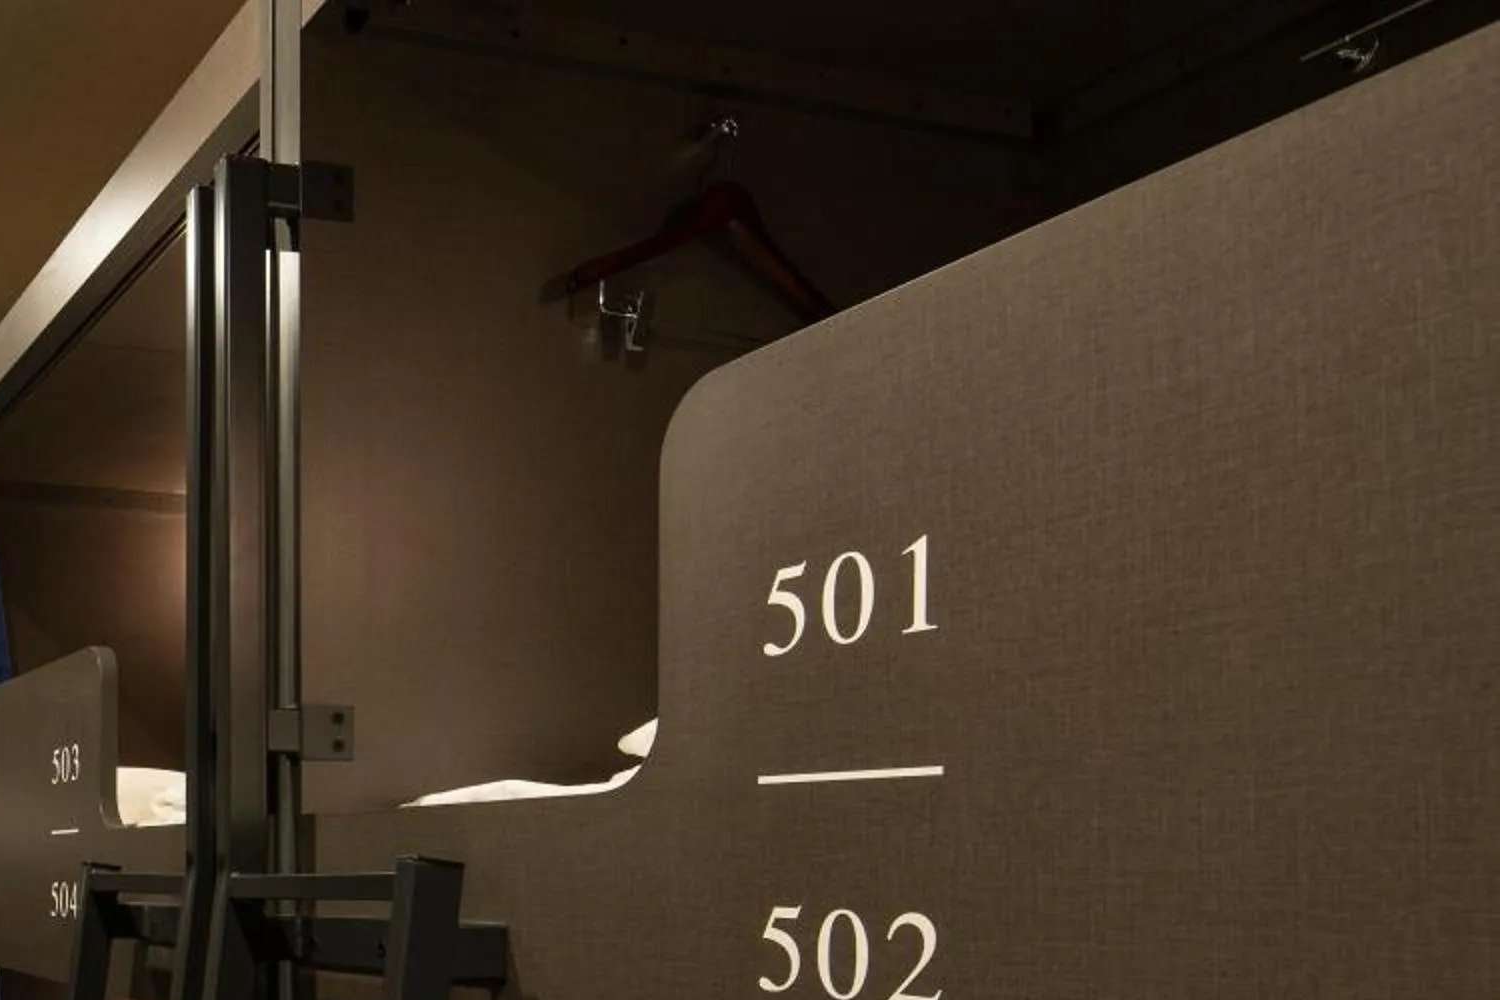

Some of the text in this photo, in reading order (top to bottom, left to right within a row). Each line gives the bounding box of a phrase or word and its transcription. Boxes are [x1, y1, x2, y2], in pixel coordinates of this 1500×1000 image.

[762, 533, 939, 657] 501
[50, 742, 81, 786] 503
[50, 880, 78, 919] 504
